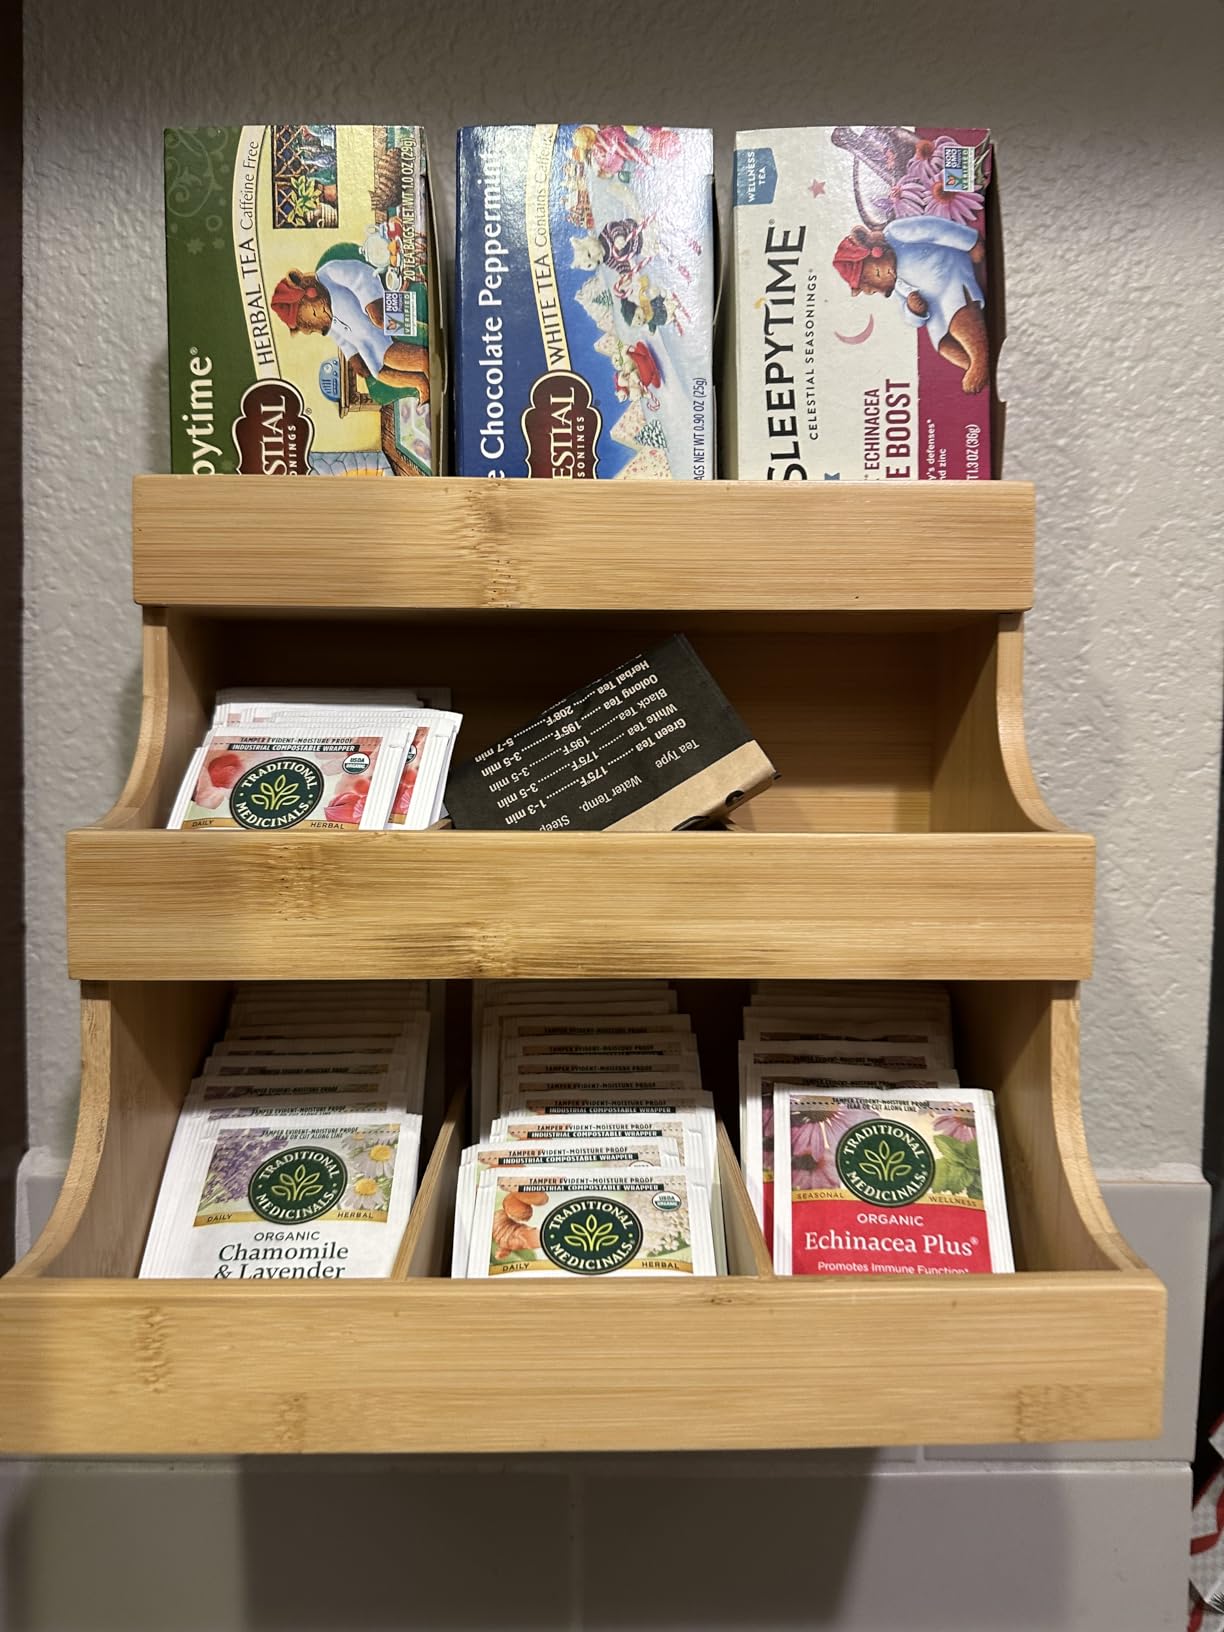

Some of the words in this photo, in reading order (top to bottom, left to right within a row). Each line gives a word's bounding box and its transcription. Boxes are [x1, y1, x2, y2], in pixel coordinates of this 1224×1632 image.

[242, 141, 259, 170] Free
[400, 137, 416, 160] (29g)
[402, 162, 414, 174] OZ
[748, 151, 756, 202] WELLNESS
[758, 166, 766, 186] TEA
[402, 176, 414, 189] 1.0
[240, 173, 254, 230] Caffeine
[402, 191, 414, 206] WT
[402, 208, 414, 224] NET
[535, 187, 547, 248] Contains
[477, 148, 509, 306] Peppermint
[402, 226, 415, 250] BAGS
[238, 238, 258, 279] TEA
[403, 252, 415, 268] TEA
[403, 270, 416, 281] 20
[534, 254, 553, 292] TEA
[246, 284, 274, 365] HERBAL
[540, 297, 566, 365] WHITE
[479, 317, 504, 459] Chocolate
[692, 378, 707, 398] (25g)
[693, 401, 704, 412] OZ
[806, 368, 819, 440] CELESTIAL
[693, 414, 704, 431] 0.90
[886, 378, 911, 458] BOOST
[864, 388, 880, 470] ECHINACEA
[965, 424, 981, 448] (36g)
[577, 416, 586, 478] SONINGS
[693, 433, 704, 446] WT
[693, 448, 704, 462] NET
[938, 448, 946, 467] zinc
[966, 448, 979, 461] OZ
[886, 466, 910, 478] E
[966, 462, 978, 473] 1.3
[616, 660, 650, 681] Herbal
[596, 680, 617, 695] Tea
[622, 674, 658, 698] Oolong
[603, 695, 623, 710] Tea
[637, 688, 668, 710] Black
[646, 703, 678, 724] White
[627, 721, 647, 736] Tea
[654, 718, 686, 740] Green
[272, 744, 321, 752] COMPOSTABLE
[497, 737, 514, 752] 5-7
[636, 736, 656, 752] Tea
[678, 739, 700, 754] Tea
[474, 748, 494, 763] min
[502, 751, 522, 768] 3-5
[655, 750, 681, 769] Type
[242, 761, 318, 790] TRADITIONAL
[480, 762, 502, 777] min
[512, 766, 530, 782] 3-5
[488, 778, 510, 793] min
[519, 782, 538, 798] 3-5
[612, 775, 642, 797] Water
[496, 794, 518, 809] min
[528, 799, 547, 814] 1-3
[579, 792, 612, 812] Temp.
[236, 802, 310, 828] MEDICINALS
[504, 810, 526, 825] min
[310, 822, 345, 830] HERBAL
[843, 1124, 926, 1160] TRADITIONAL
[538, 1148, 604, 1156] EVIDENT-MOISTURE
[259, 1150, 340, 1180] TRADITIONAL
[847, 1170, 926, 1200] MEDICINALS
[796, 1192, 844, 1200] SEASONAL
[928, 1196, 977, 1207] WELLNESS
[256, 1191, 336, 1220] MEDICINALS
[207, 1214, 232, 1222] DAILY
[549, 1200, 634, 1230] TRADITIONAL
[856, 1213, 924, 1226] ORGANIC
[254, 1231, 320, 1241] ORGANIC
[804, 1229, 918, 1253] Echinacea
[219, 1242, 348, 1262] Chamomile
[551, 1242, 633, 1270] MEDICINALS
[214, 1264, 232, 1279] &
[238, 1261, 346, 1279] Lavender
[502, 1263, 530, 1272] DAILY
[818, 1262, 869, 1272] Promotes
[871, 1264, 915, 1274] Immune
